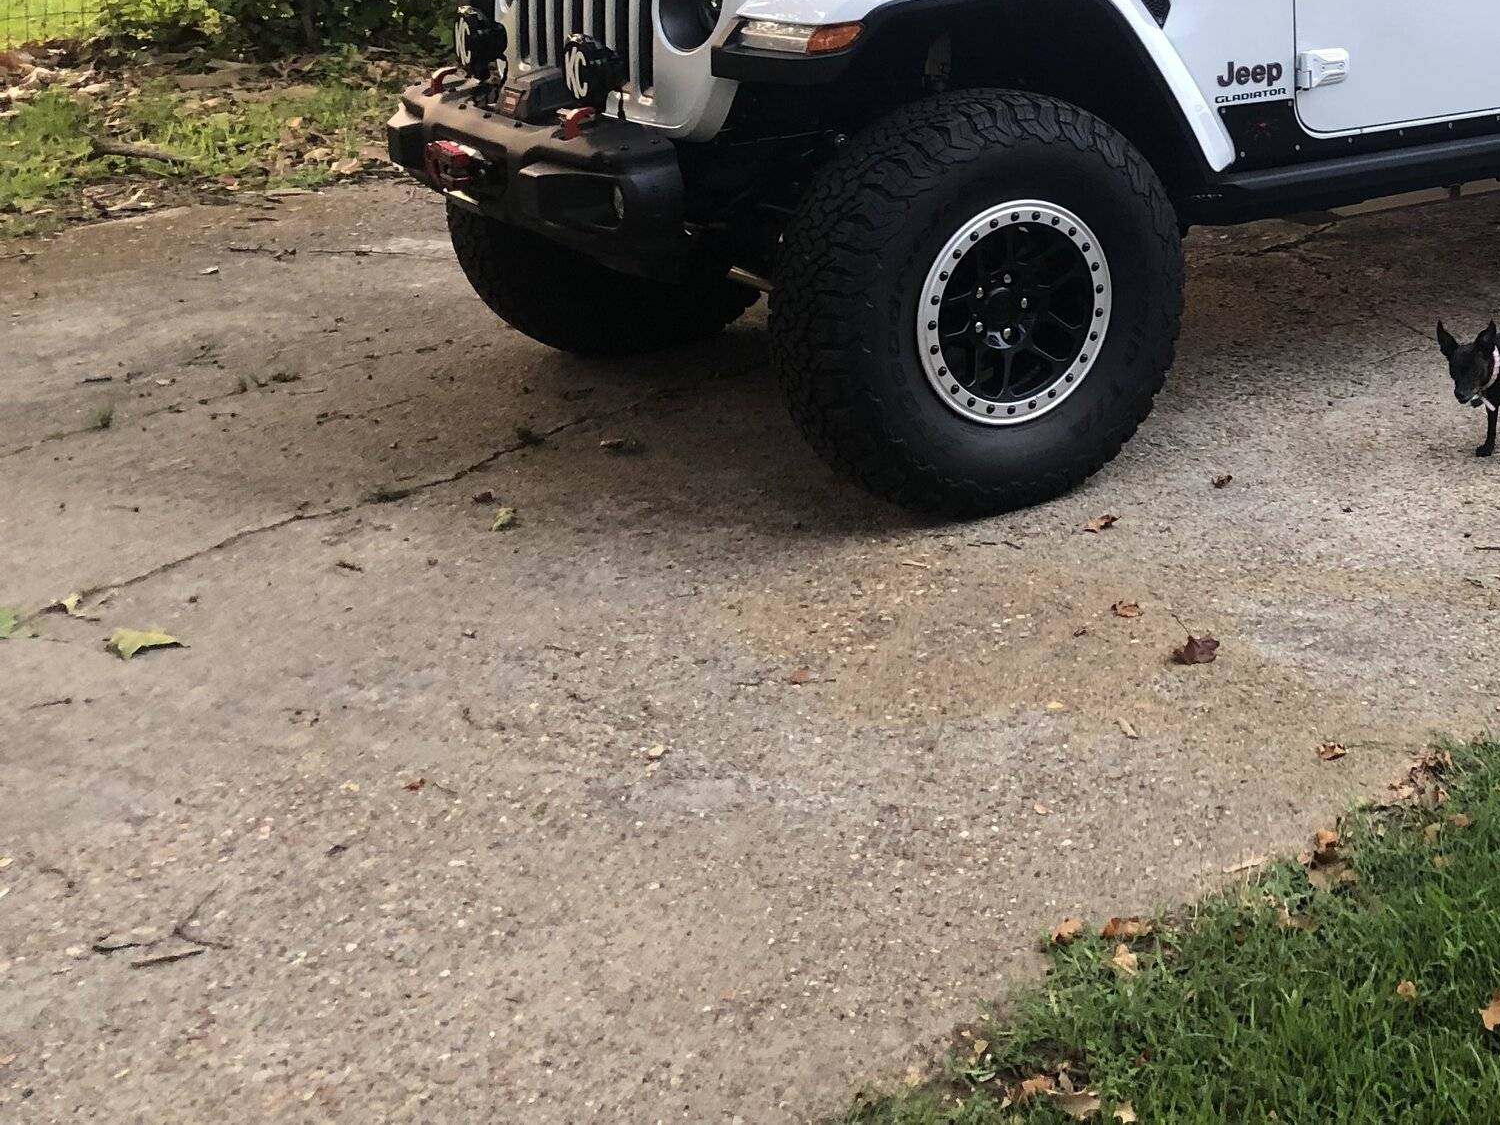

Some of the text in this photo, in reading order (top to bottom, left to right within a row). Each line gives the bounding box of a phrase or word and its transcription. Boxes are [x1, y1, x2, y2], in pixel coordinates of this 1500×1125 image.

[454, 17, 471, 66] KC
[565, 46, 588, 99] KC
[1216, 61, 1283, 87] Jeep
[1214, 87, 1287, 104] GLADIATOR
